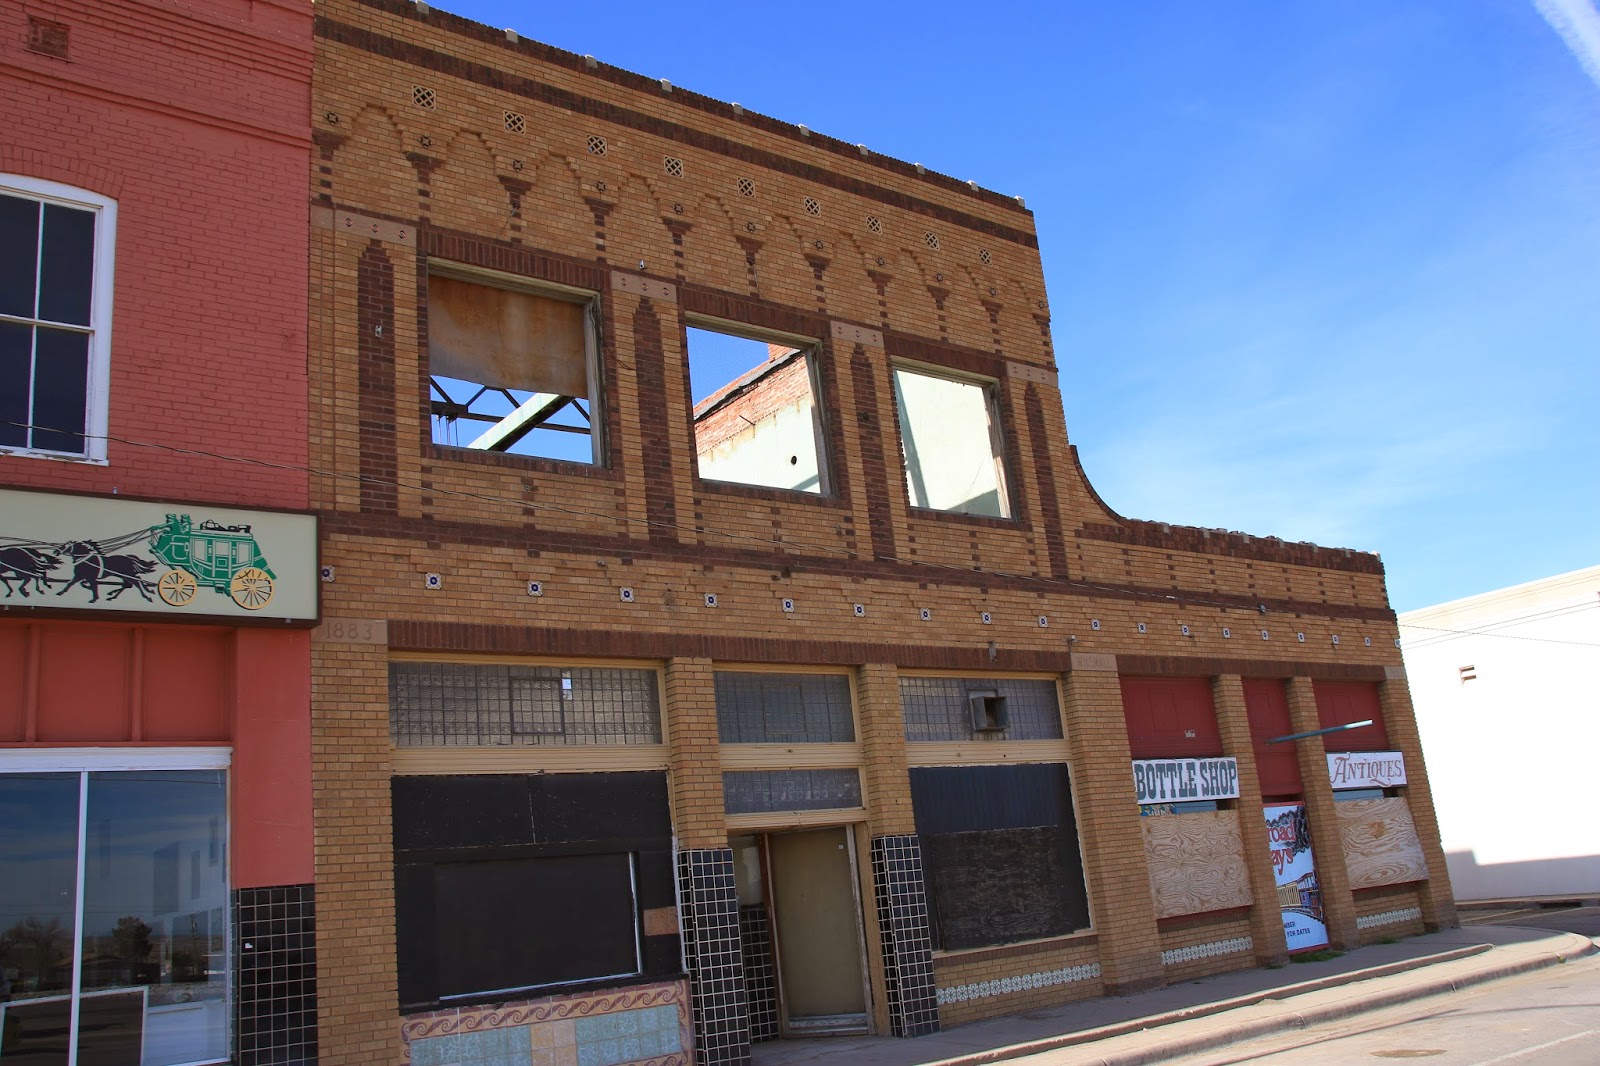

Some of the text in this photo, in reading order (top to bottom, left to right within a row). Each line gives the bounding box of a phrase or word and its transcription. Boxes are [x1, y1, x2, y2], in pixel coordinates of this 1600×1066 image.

[327, 621, 372, 640] 1883
[1134, 760, 1236, 800] BOTTLE SHOP
[1330, 753, 1402, 788] ANTIQUES
[1296, 928, 1310, 936] DATES
